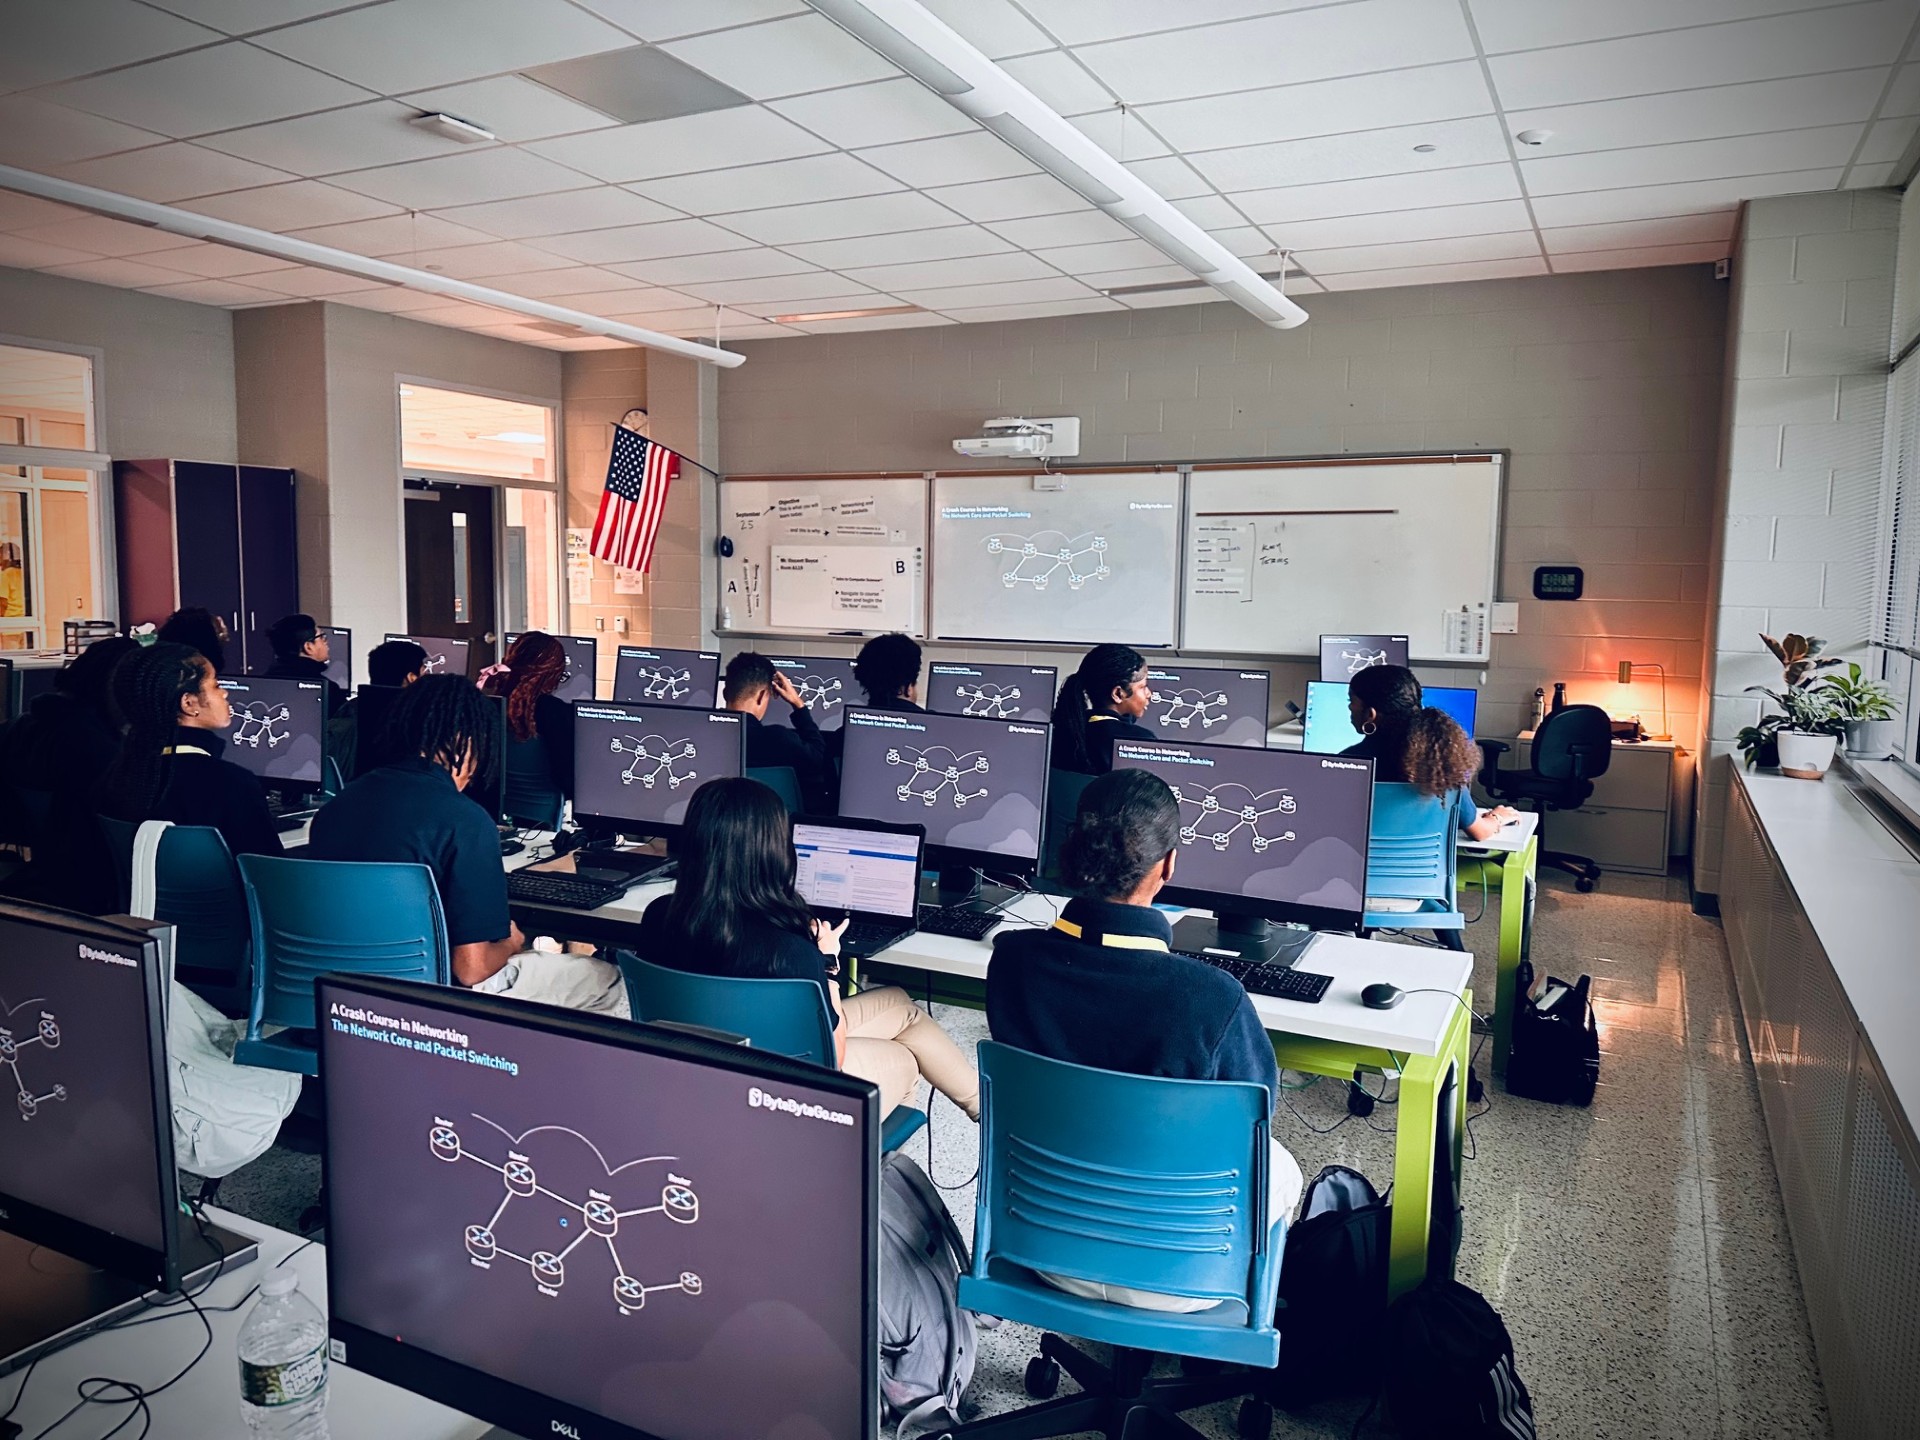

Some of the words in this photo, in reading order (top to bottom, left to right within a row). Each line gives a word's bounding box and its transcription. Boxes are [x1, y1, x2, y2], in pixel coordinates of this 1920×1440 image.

[740, 520, 754, 530] 25
[896, 560, 905, 574] B
[728, 580, 736, 592] A
[331, 1003, 338, 1015] A
[340, 1004, 365, 1022] Crash
[367, 1011, 399, 1029] Course
[401, 1017, 410, 1032] in
[411, 1020, 468, 1047] Networking
[332, 1019, 348, 1033] The
[350, 1022, 389, 1044] Network
[390, 1032, 412, 1049] Core
[414, 1039, 432, 1054] and
[433, 1042, 466, 1062] Packet
[468, 1050, 519, 1076] Switching
[763, 1093, 854, 1126] ByteByteGo.com
[551, 1420, 581, 1440] DELL
